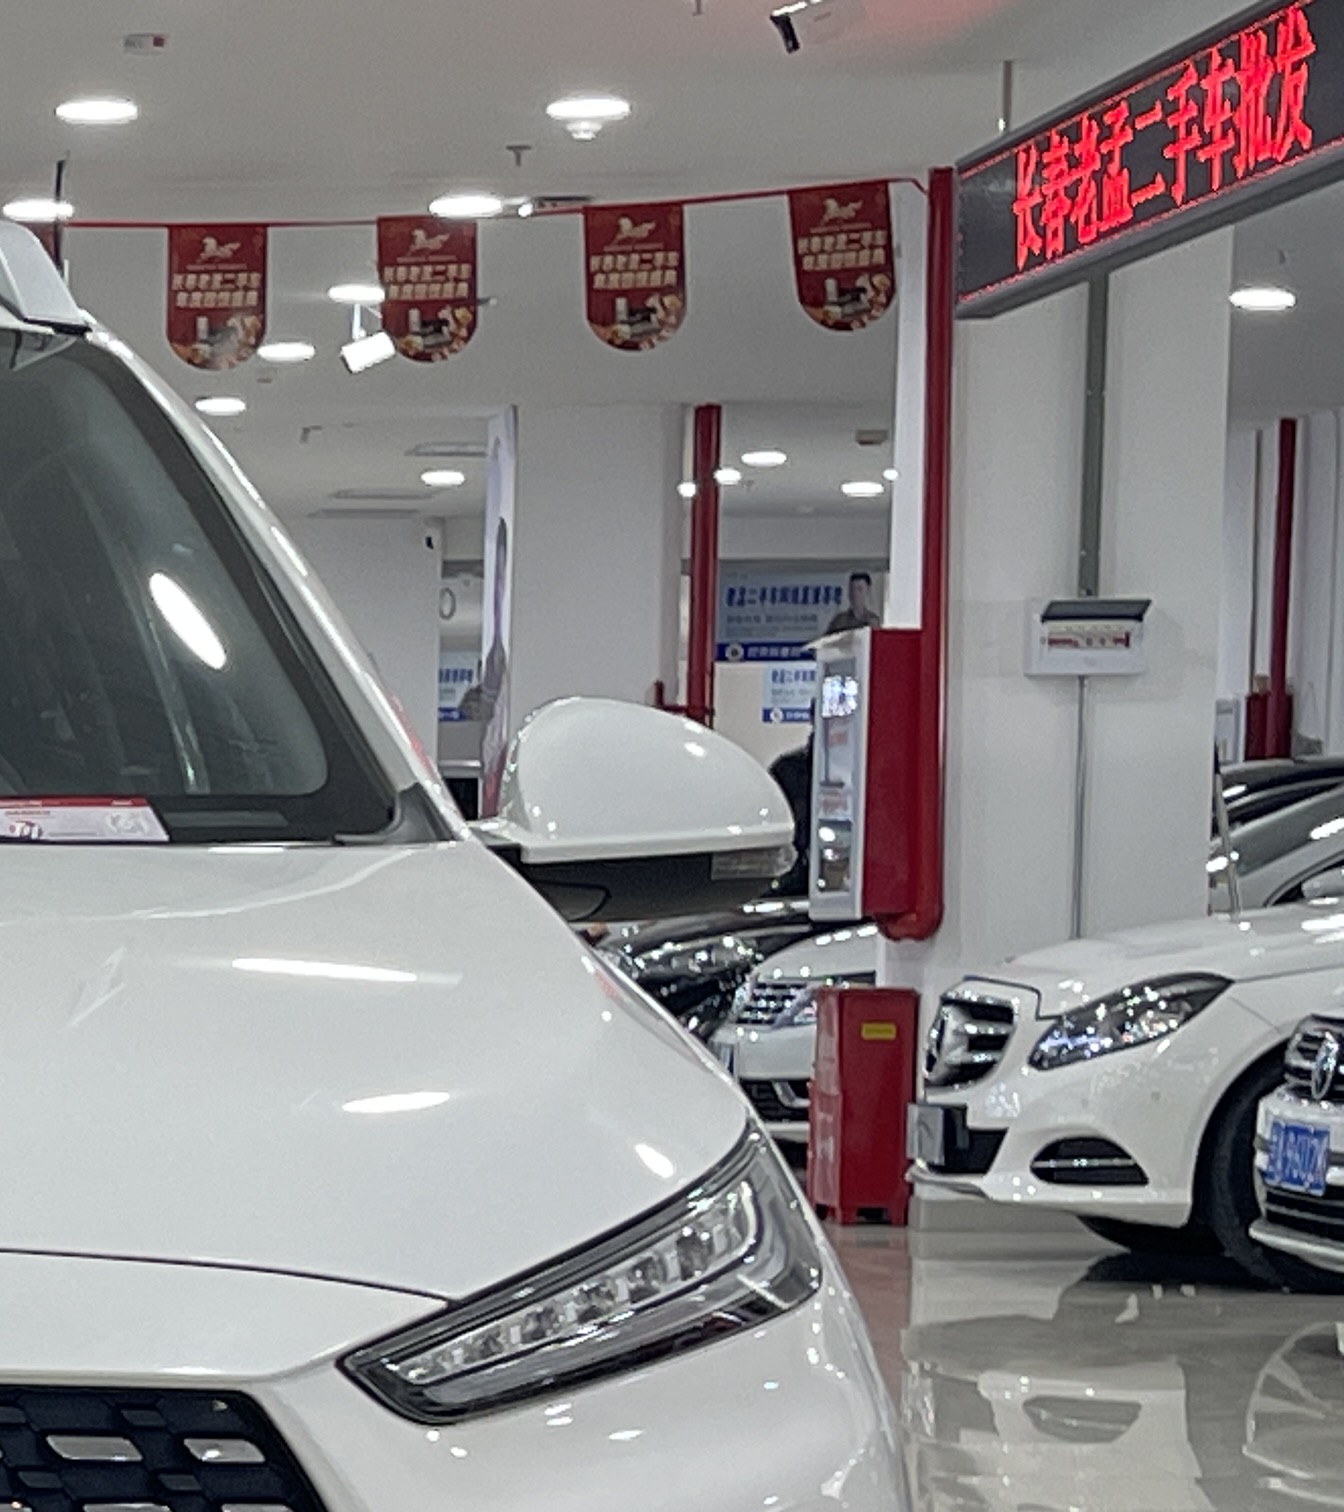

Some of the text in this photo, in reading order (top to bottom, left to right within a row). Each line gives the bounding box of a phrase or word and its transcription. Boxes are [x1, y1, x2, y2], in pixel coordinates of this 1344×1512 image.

[1012, 5, 1315, 271] 长春老孟二手车批发
